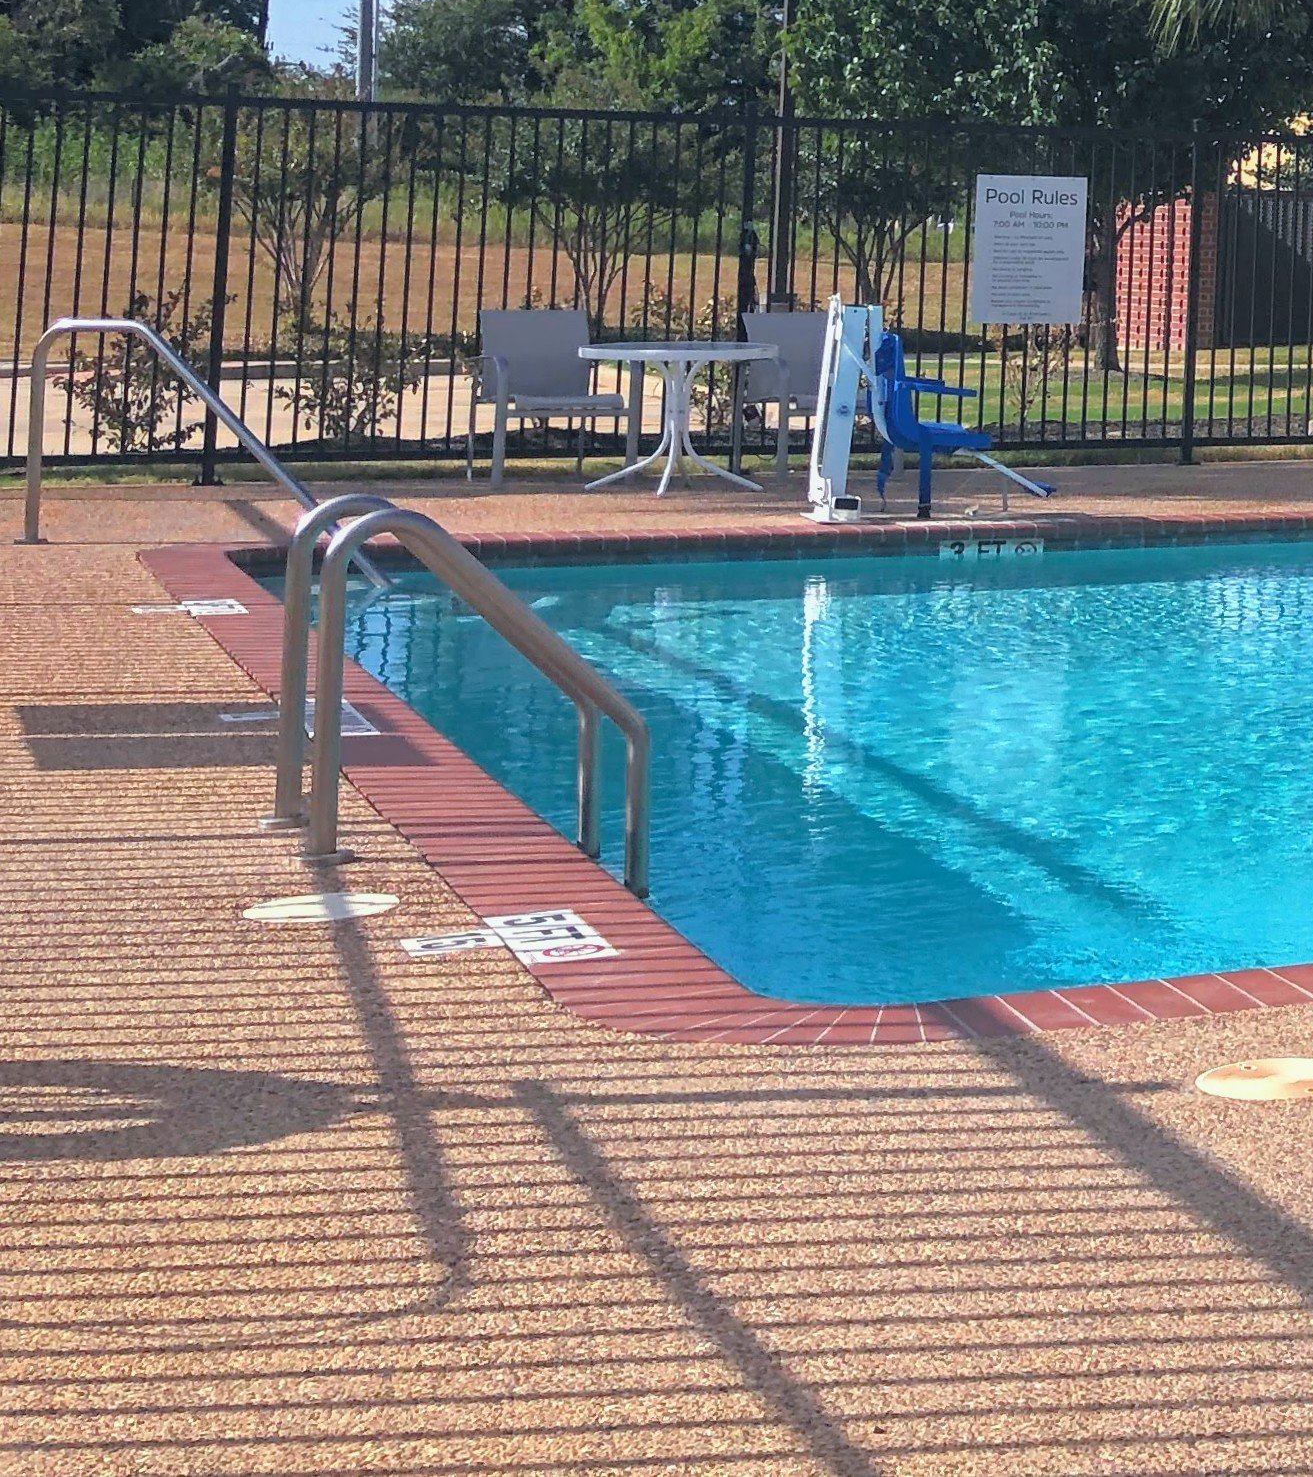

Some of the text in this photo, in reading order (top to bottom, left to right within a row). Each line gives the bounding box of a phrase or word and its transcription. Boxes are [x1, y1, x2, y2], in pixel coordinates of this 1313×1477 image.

[986, 188, 1078, 205] Pool Rules
[1009, 211, 1027, 219] Pool
[993, 220, 1010, 228] 7:00
[1033, 221, 1055, 229] 10:00
[1056, 221, 1069, 229] PM
[977, 540, 1007, 555] FT
[502, 913, 586, 943] 5 FT
